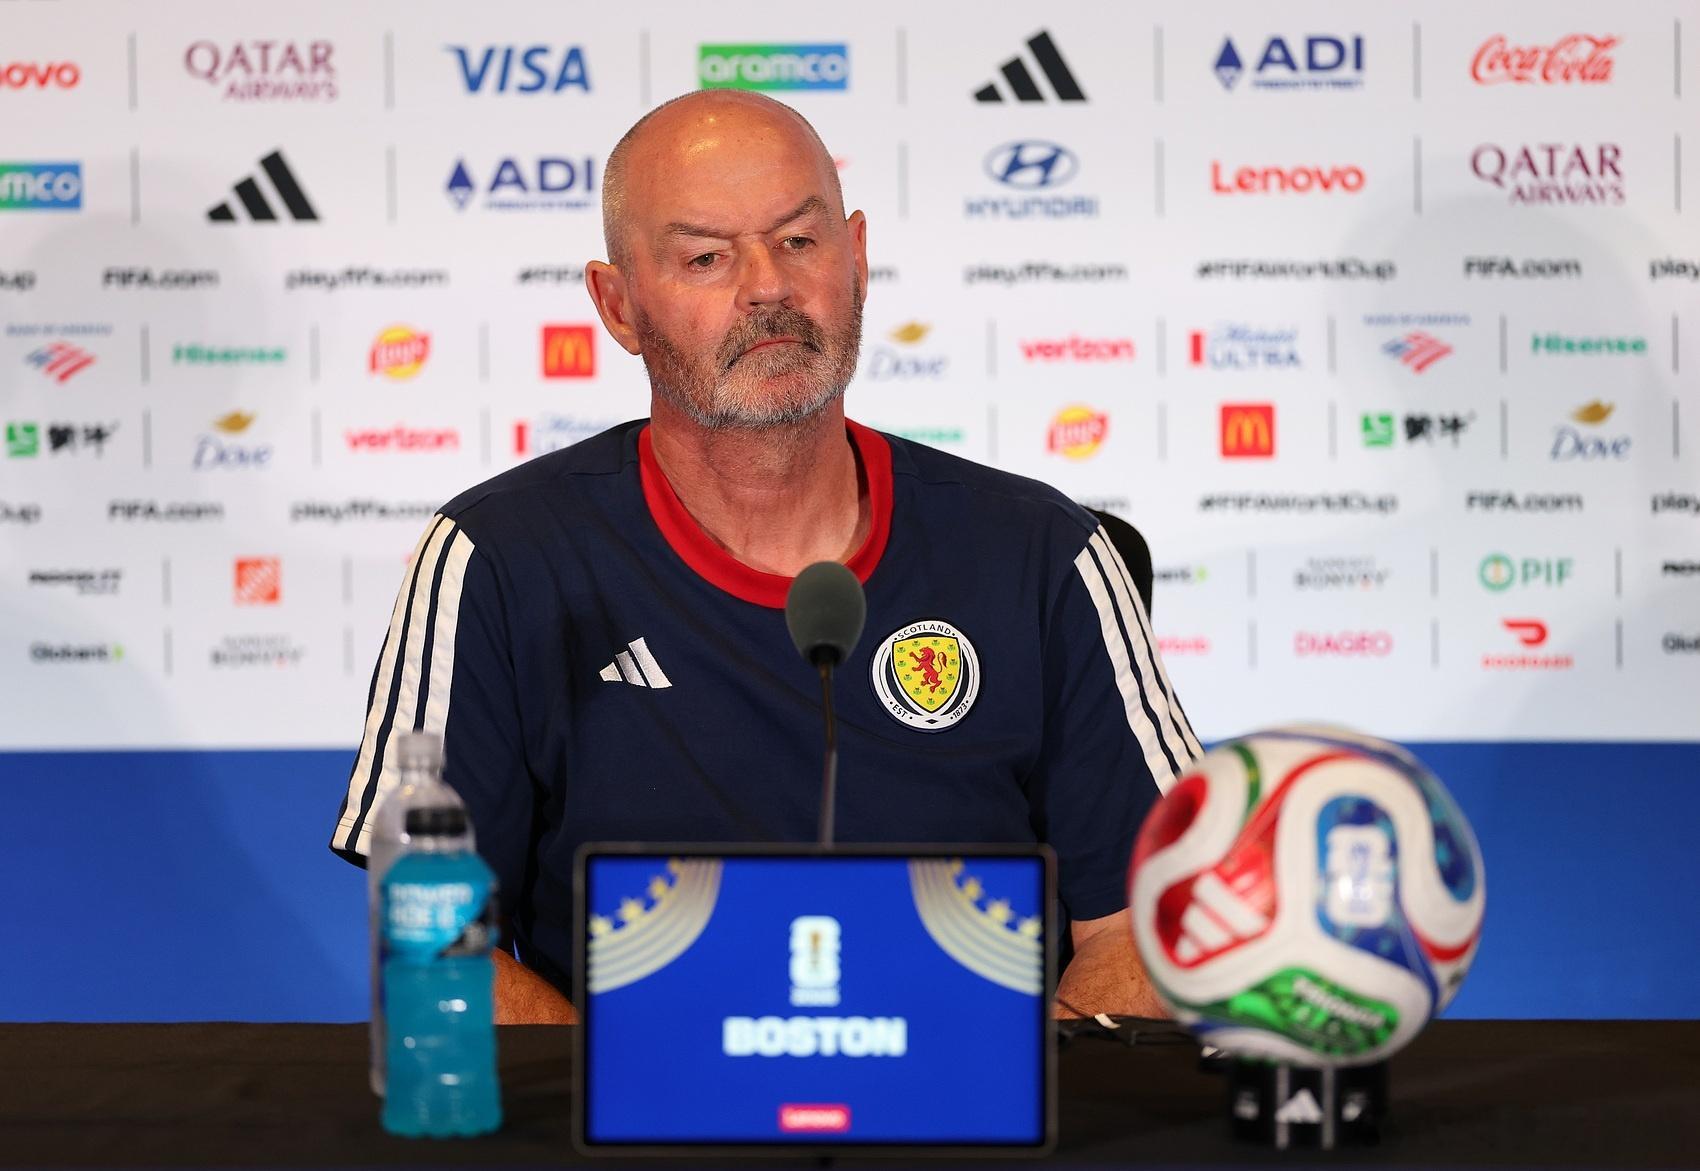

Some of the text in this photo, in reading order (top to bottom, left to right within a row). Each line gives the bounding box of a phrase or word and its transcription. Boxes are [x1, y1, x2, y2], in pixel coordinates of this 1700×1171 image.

[184, 41, 336, 83] QATAR
[1255, 36, 1364, 73] ADI
[0, 63, 80, 88] ovo
[446, 45, 592, 93] VISA
[701, 54, 848, 83] aramco
[488, 159, 594, 194] ADI
[1211, 161, 1366, 194] Lenovo
[1470, 144, 1623, 188] QATAR
[965, 197, 1099, 219] HYUNDAI
[1509, 185, 1625, 205] AIRWAYS
[102, 268, 218, 288] FIFA.com
[1464, 258, 1581, 278] FIFA.com
[172, 343, 287, 365] Hisense
[1021, 336, 1135, 362] verizon
[1531, 333, 1648, 355] Hisense
[868, 348, 948, 379] Dove
[1210, 350, 1301, 369] ULTRA
[346, 426, 460, 452] verizon
[1550, 426, 1632, 460] Dove
[191, 436, 272, 471] Dove
[1466, 492, 1583, 511] FIFA.com
[1520, 558, 1573, 586] PIF
[897, 623, 951, 639] SCOTLAND
[1295, 631, 1393, 656] DIAGEO
[892, 704, 908, 718] EST
[952, 702, 968, 719] 1873
[722, 1016, 907, 1057] BOSTON
